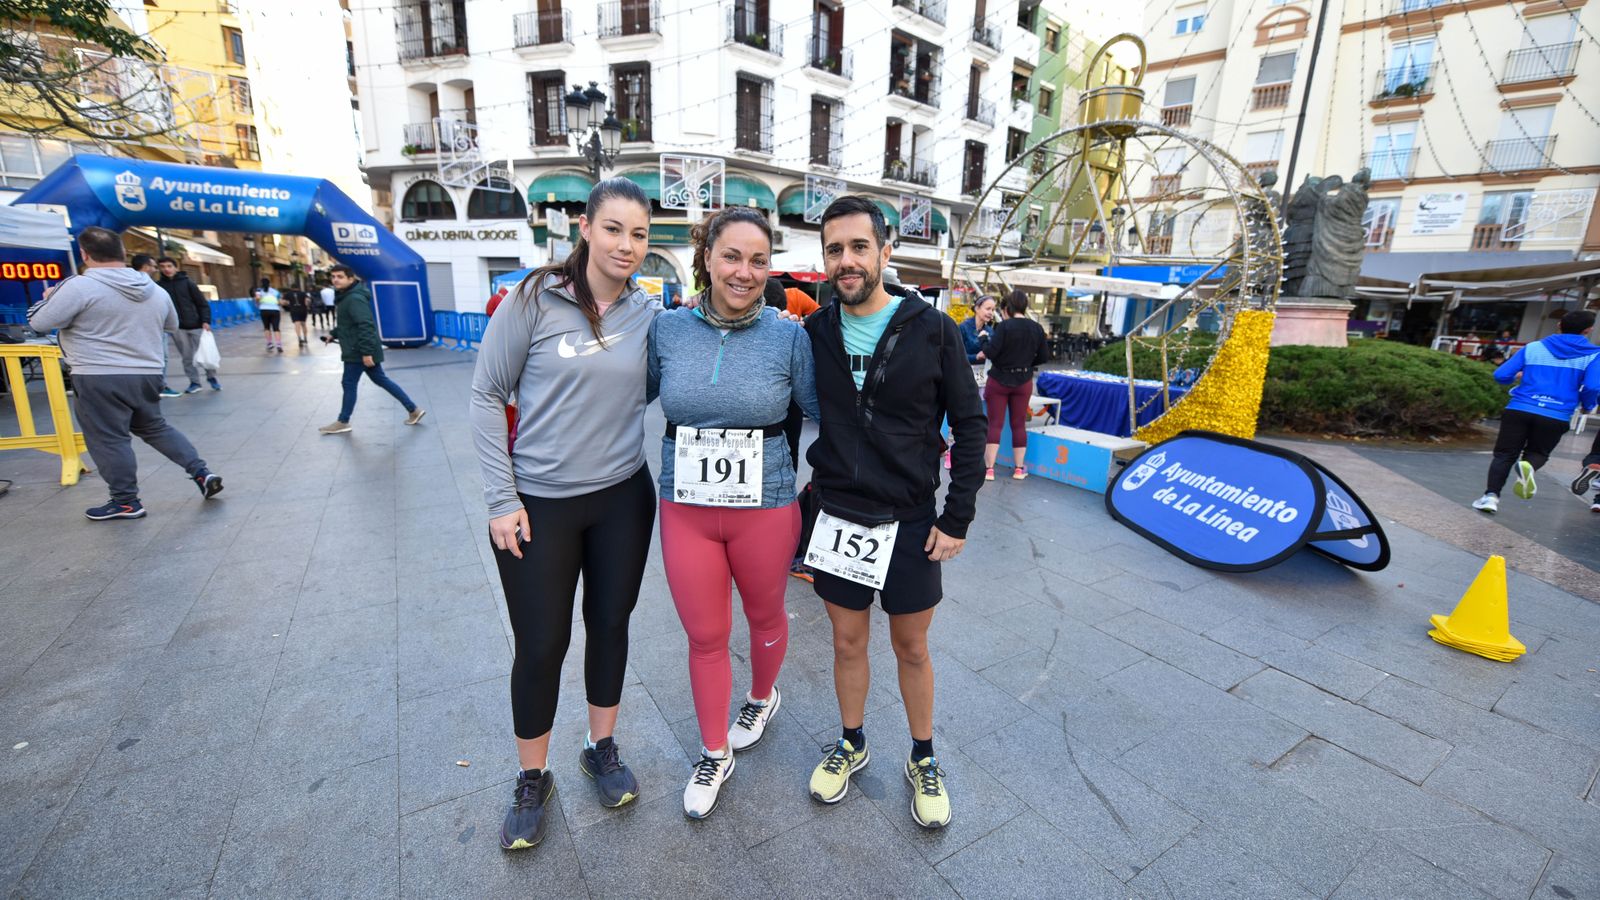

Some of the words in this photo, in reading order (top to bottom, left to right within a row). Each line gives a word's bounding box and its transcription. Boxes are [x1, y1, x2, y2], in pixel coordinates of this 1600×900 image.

[150, 176, 291, 200] Ayuntamiento
[169, 197, 195, 211] de
[200, 199, 223, 214] La
[227, 201, 279, 217] Línea
[338, 228, 350, 238] D
[405, 228, 440, 240] CLÍNICA
[442, 230, 475, 240] DENTAL
[477, 230, 518, 240] CROOKE
[337, 248, 380, 256] DEPORTES
[1056, 445, 1069, 464] 3
[698, 457, 748, 484] 191
[1160, 462, 1298, 523] Ayuntamiento
[1152, 486, 1178, 505] de
[1172, 494, 1202, 516] La
[1196, 504, 1259, 543] Línea
[831, 529, 879, 565] 152
